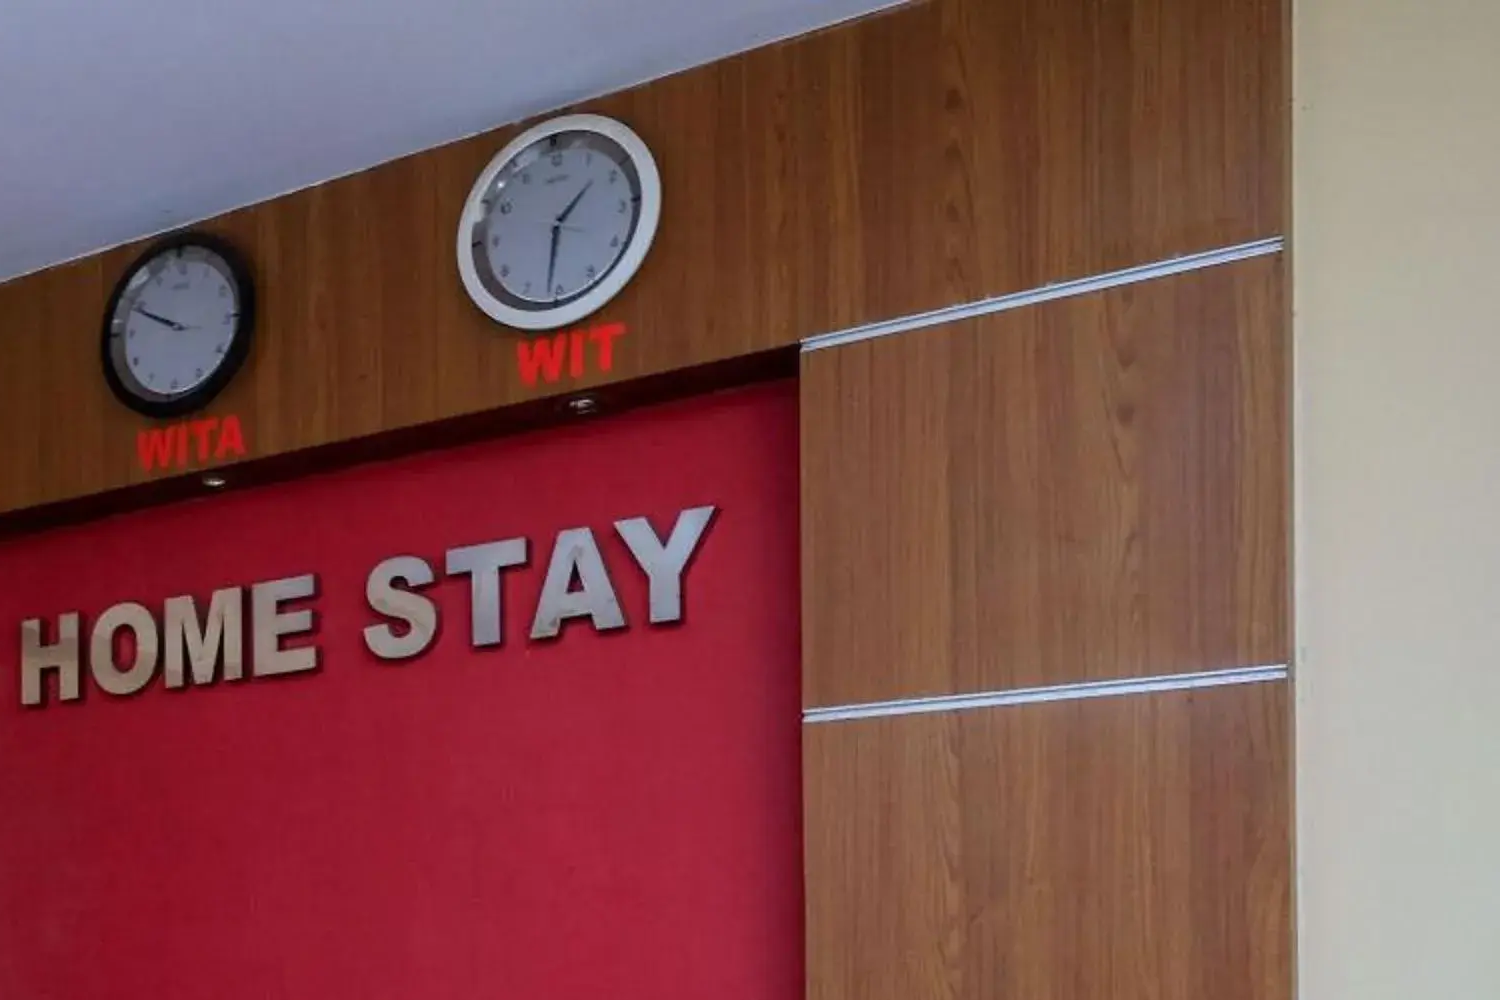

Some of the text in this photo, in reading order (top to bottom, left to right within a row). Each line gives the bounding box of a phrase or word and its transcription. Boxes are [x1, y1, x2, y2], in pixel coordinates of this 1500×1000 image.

[518, 322, 626, 385] WIT
[138, 416, 247, 471] WITA
[19, 573, 318, 706] HOME
[362, 505, 716, 660] STAY
